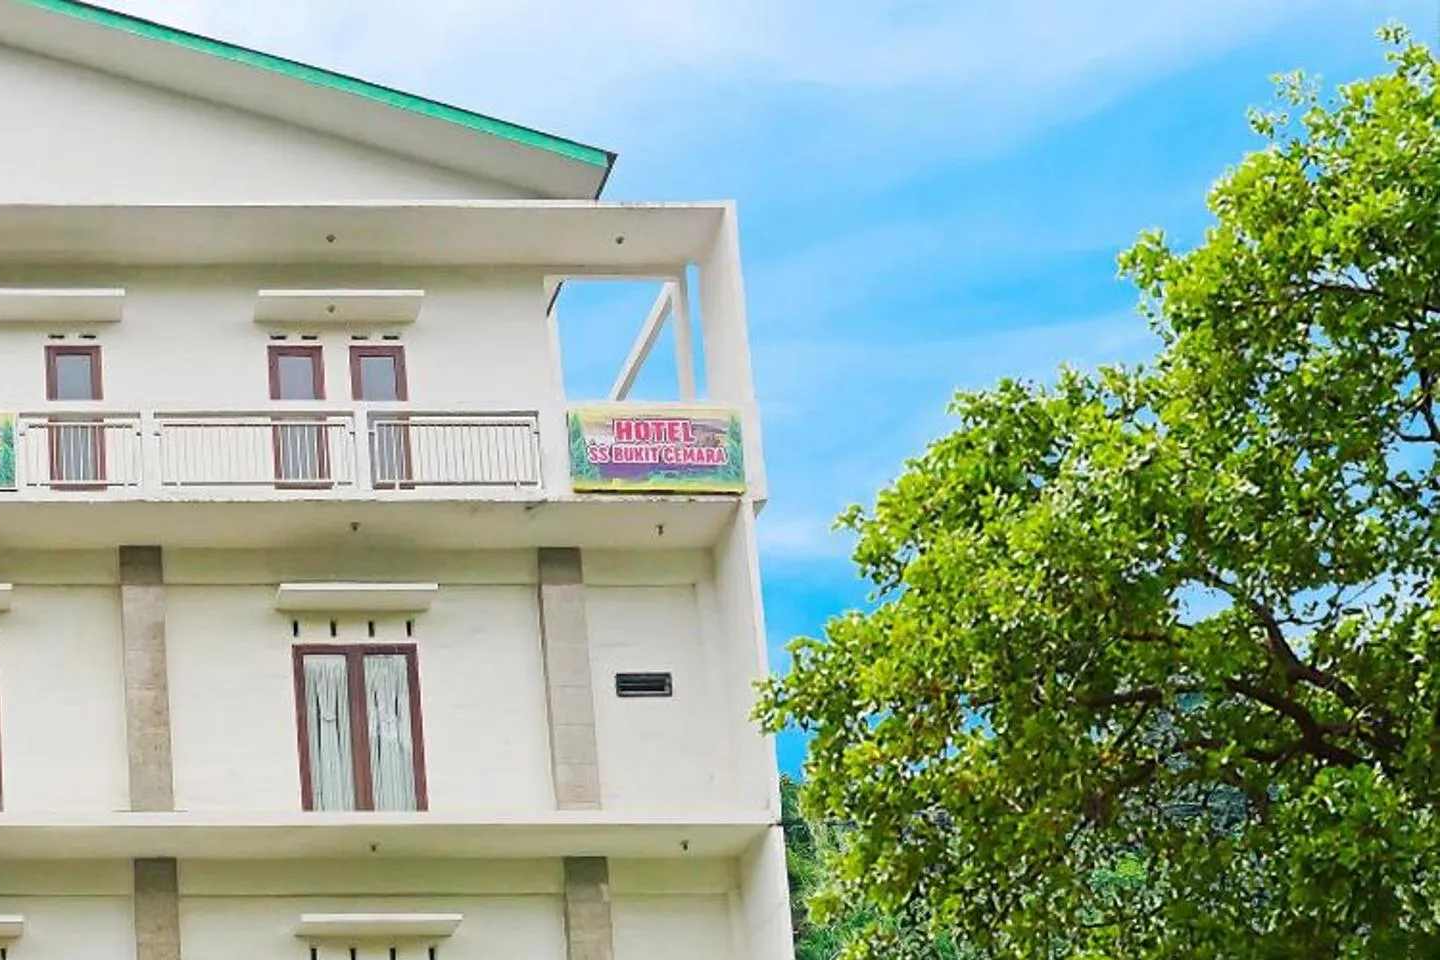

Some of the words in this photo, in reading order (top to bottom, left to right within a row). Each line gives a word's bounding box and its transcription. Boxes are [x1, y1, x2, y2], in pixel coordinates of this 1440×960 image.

[614, 420, 696, 444] HOTEL
[588, 446, 610, 463] SS
[613, 446, 659, 463] BUKIT
[663, 446, 728, 464] CEMARA
